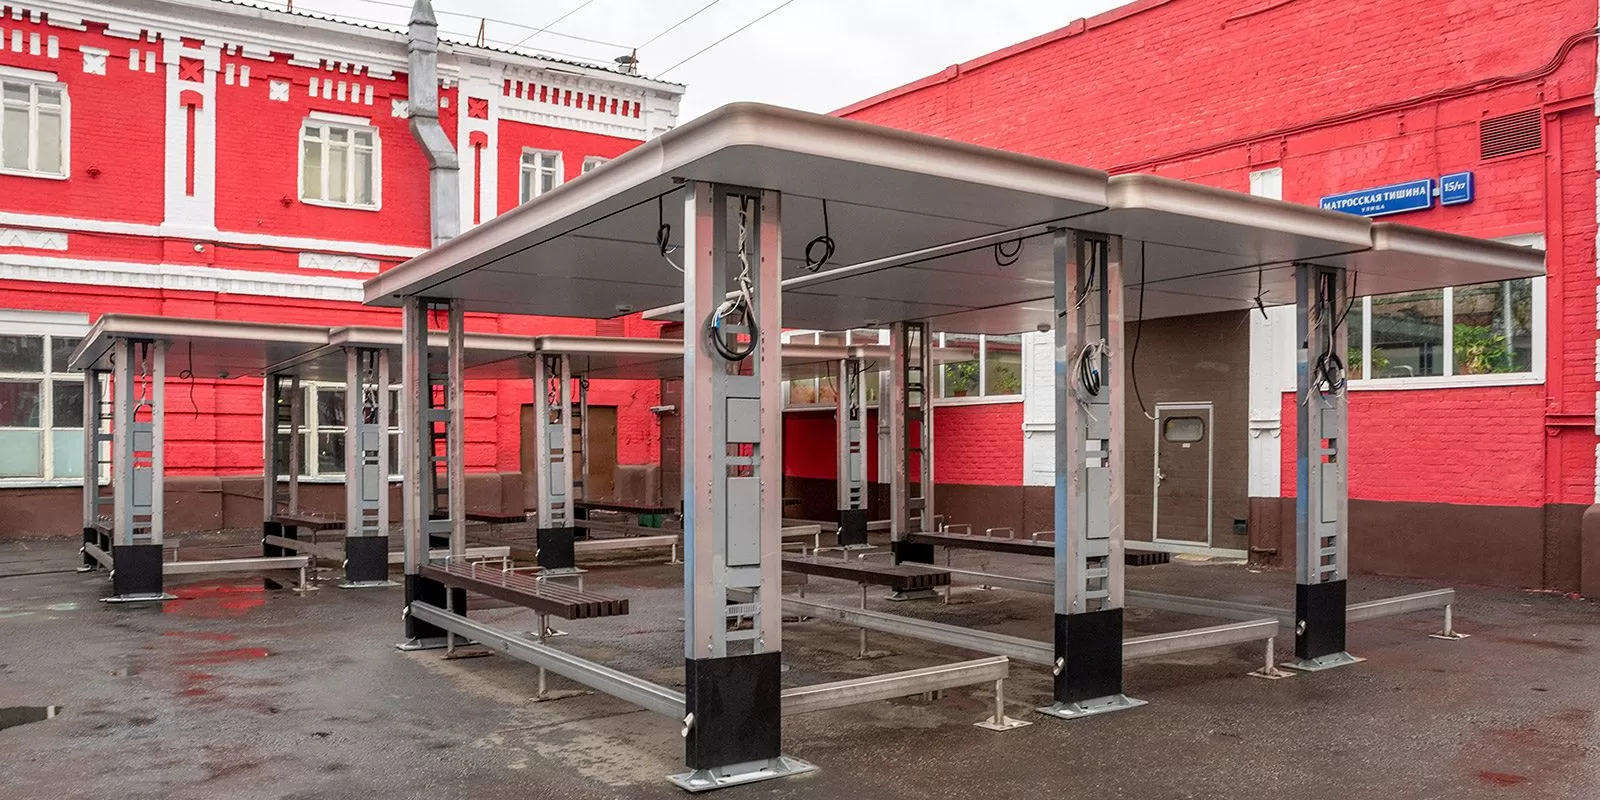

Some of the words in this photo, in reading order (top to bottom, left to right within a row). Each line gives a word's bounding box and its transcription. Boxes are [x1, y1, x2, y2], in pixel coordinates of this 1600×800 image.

[1323, 193, 1382, 210] МАТРОССКАЯ
[1383, 186, 1426, 201] ТИШИНА
[1361, 204, 1385, 213] УЛИЦА
